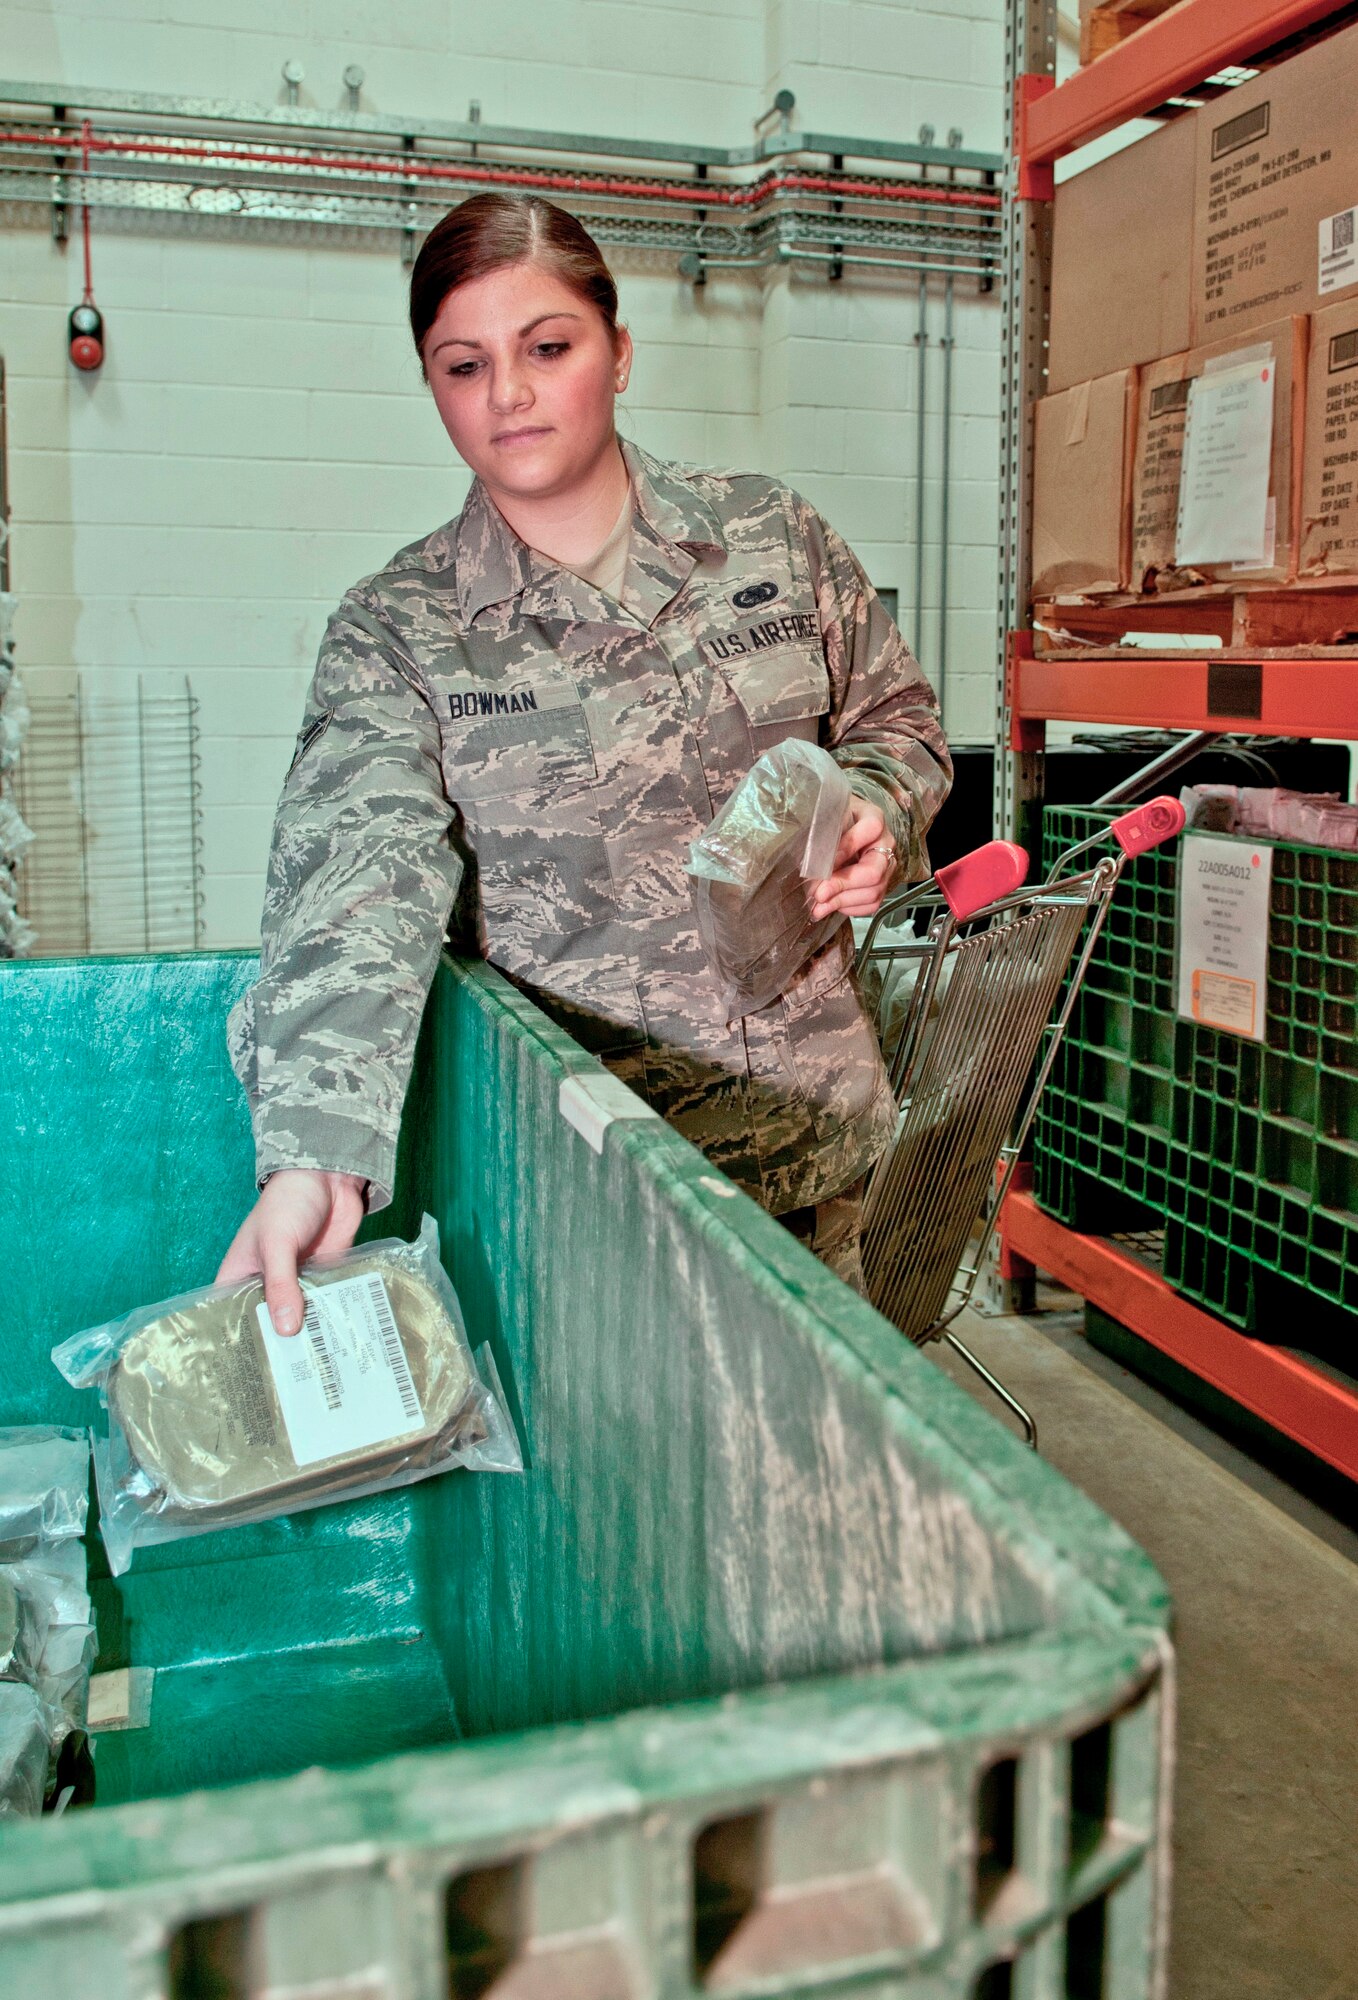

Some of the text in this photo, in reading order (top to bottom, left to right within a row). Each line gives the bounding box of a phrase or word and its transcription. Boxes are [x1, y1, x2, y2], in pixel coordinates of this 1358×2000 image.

[1261, 170, 1281, 187] AGENT
[1336, 481, 1353, 495] DATE
[1333, 497, 1350, 511] DATE
[708, 633, 752, 659] U.S.
[748, 620, 784, 650] AIR
[448, 689, 538, 719] BOWMAN
[349, 1285, 359, 1303] CAGE
